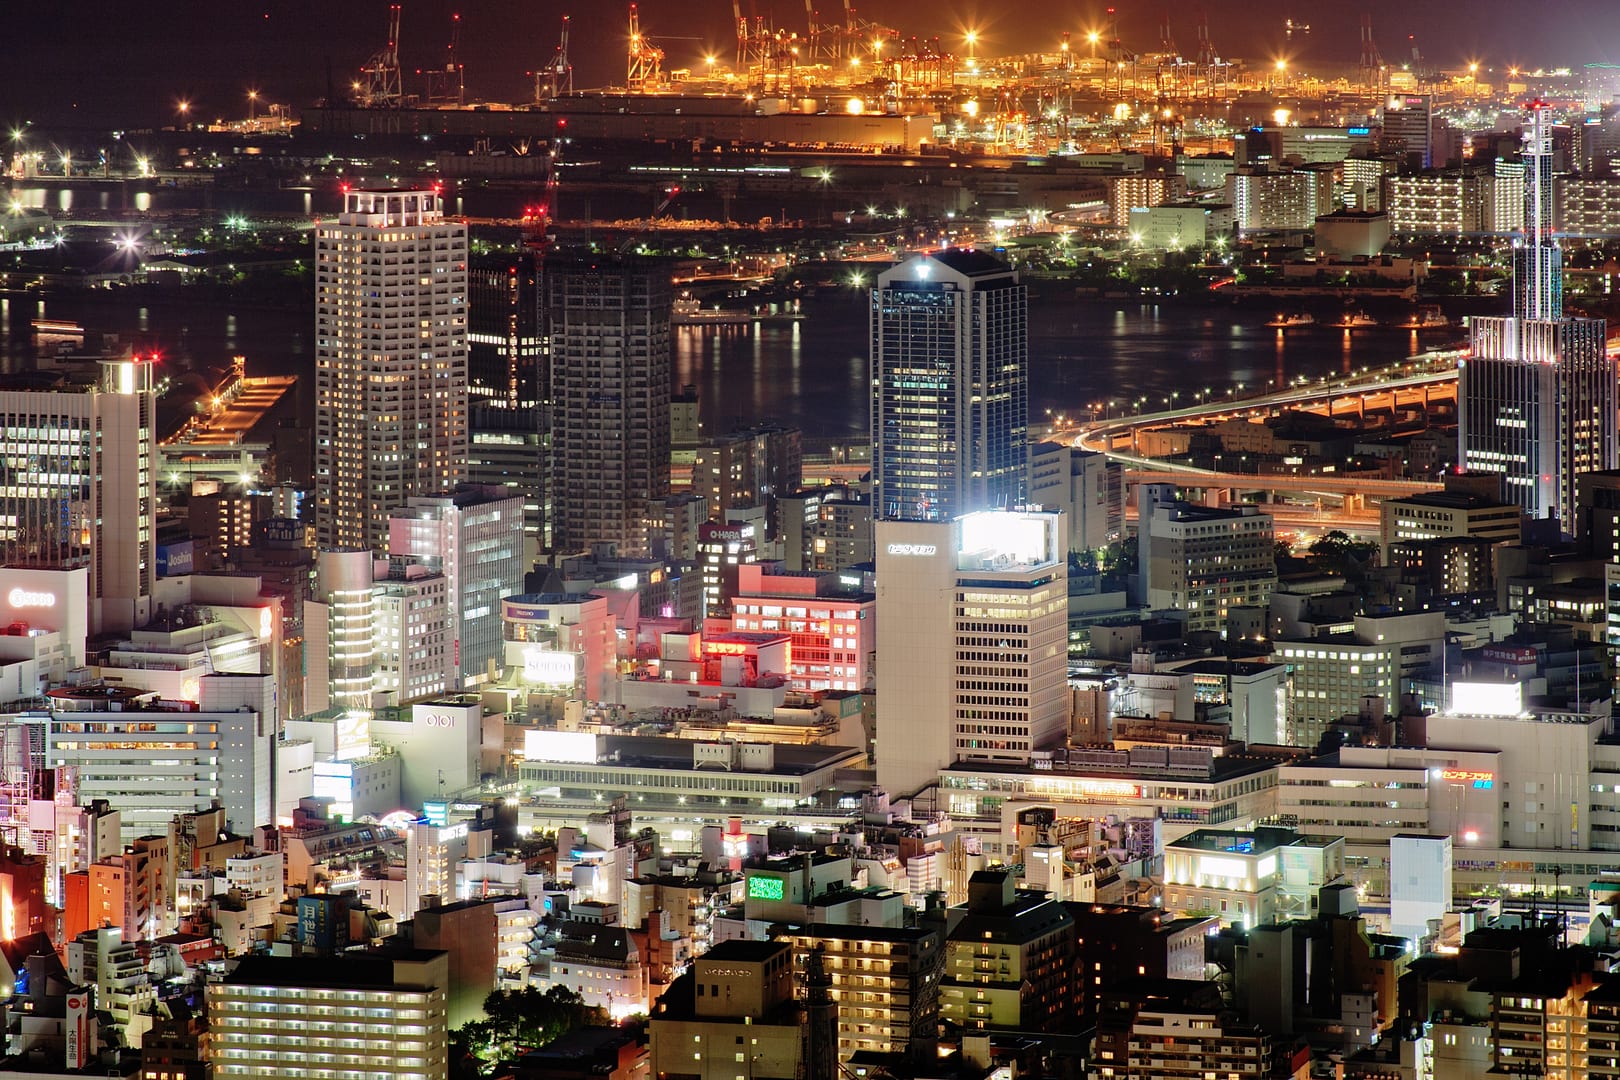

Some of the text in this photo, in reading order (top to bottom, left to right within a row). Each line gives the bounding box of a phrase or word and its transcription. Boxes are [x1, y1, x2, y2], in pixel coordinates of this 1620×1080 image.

[168, 551, 192, 567] Joshin
[749, 877, 783, 890] TOKYU
[749, 887, 783, 900] HANDS
